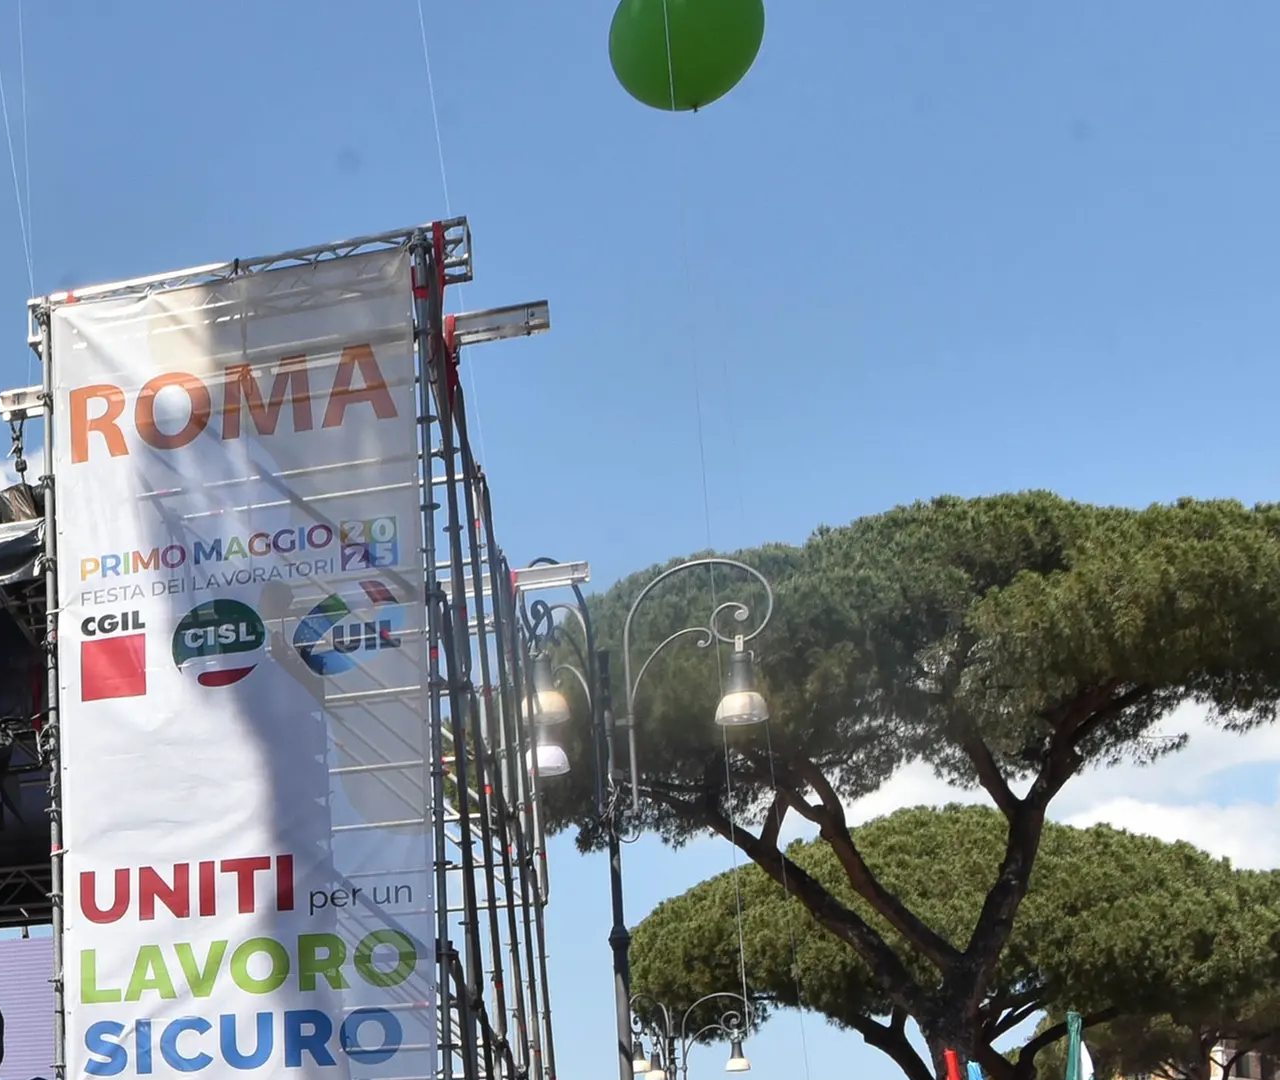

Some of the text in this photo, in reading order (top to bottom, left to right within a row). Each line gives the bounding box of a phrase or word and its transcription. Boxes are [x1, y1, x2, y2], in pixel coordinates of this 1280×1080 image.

[68, 343, 398, 465] ROMA
[80, 523, 333, 582] PRIMO MAGGIO
[81, 557, 335, 607] FESTA DEI LAVORATORI
[80, 611, 146, 637] CGIL
[183, 622, 256, 649] CISL
[332, 618, 401, 654] UIL
[80, 854, 413, 924] UNITI per un
[80, 928, 418, 1004] LAVORO
[84, 1007, 404, 1077] SICURO
